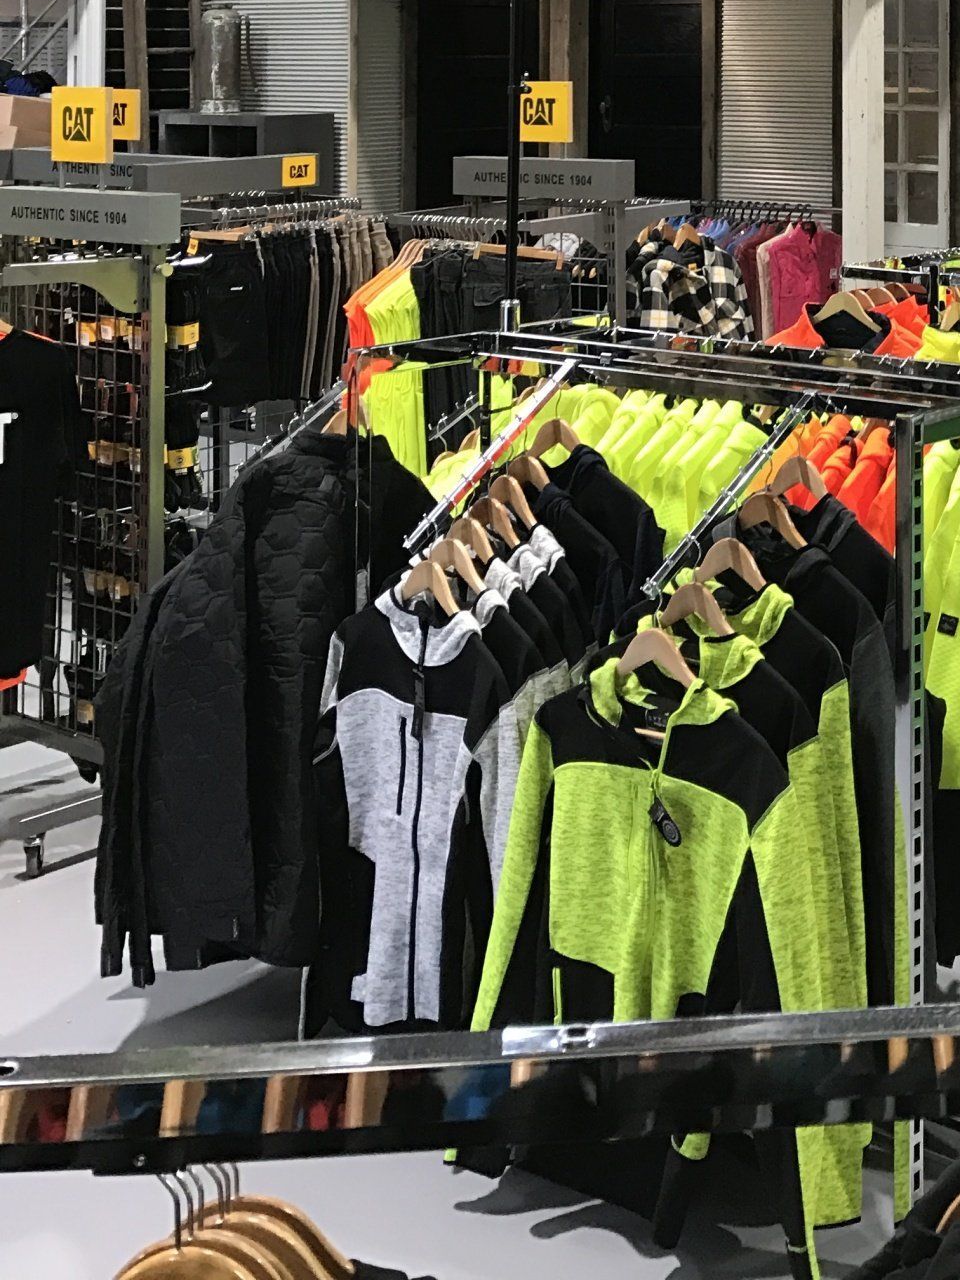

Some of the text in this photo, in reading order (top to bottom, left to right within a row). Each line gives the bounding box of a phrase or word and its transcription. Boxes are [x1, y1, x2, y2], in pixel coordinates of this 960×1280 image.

[113, 103, 127, 126] AT
[523, 98, 556, 126] CAT
[62, 106, 94, 142] CAT
[110, 166, 133, 177] SINC
[289, 164, 310, 179] CAT
[474, 172, 593, 186] AUTHEIC SINCE 1904
[11, 206, 127, 225] AUTHENTIC SINCE 1904
